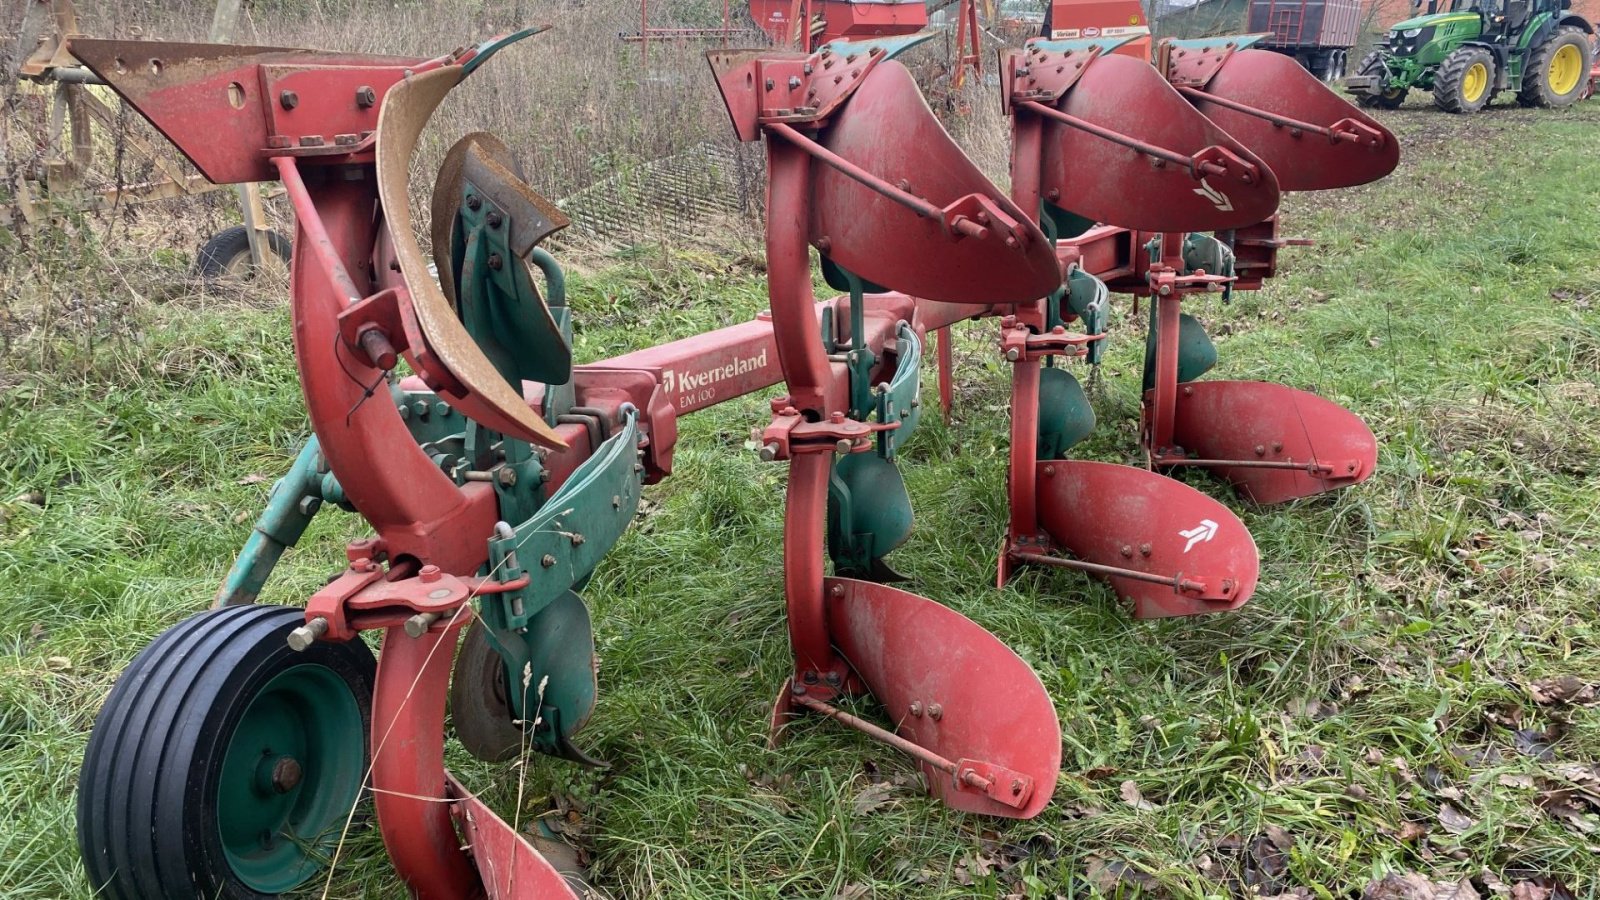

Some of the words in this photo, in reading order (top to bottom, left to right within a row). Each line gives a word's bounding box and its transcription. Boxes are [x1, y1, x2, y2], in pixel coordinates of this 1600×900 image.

[1056, 30, 1077, 38] Variant
[678, 348, 768, 393] Kverneland
[680, 395, 696, 408] EM
[698, 387, 716, 403] 100
